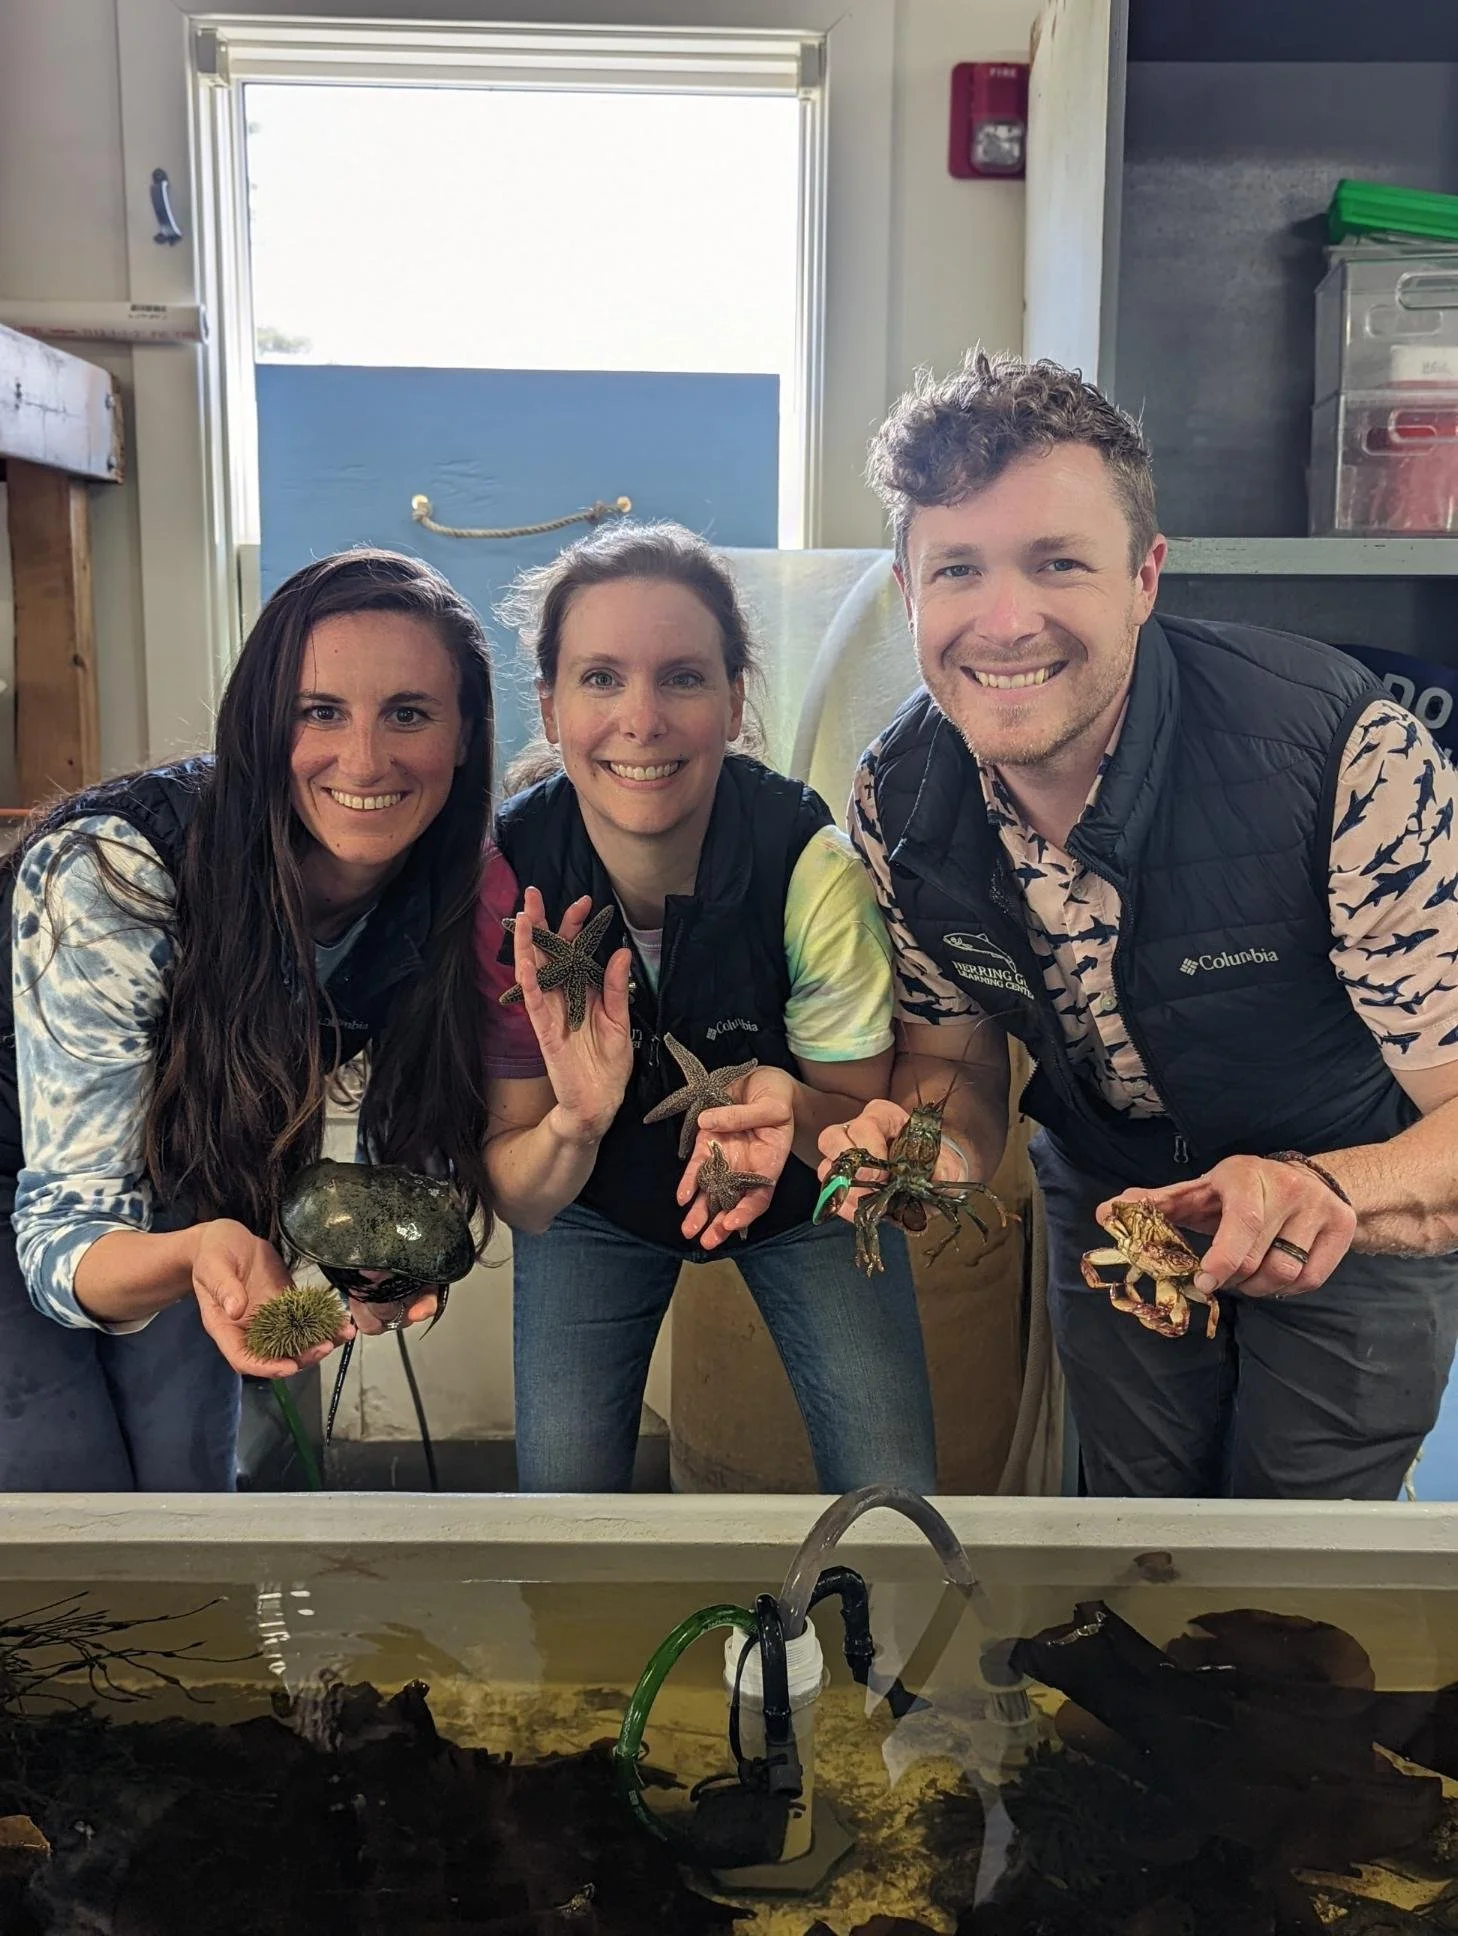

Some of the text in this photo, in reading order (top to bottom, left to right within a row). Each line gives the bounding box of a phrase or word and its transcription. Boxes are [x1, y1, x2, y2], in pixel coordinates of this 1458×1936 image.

[1199, 948, 1279, 971] Columbia
[952, 960, 1012, 981] HERRING
[957, 969, 1004, 988] LEARNING
